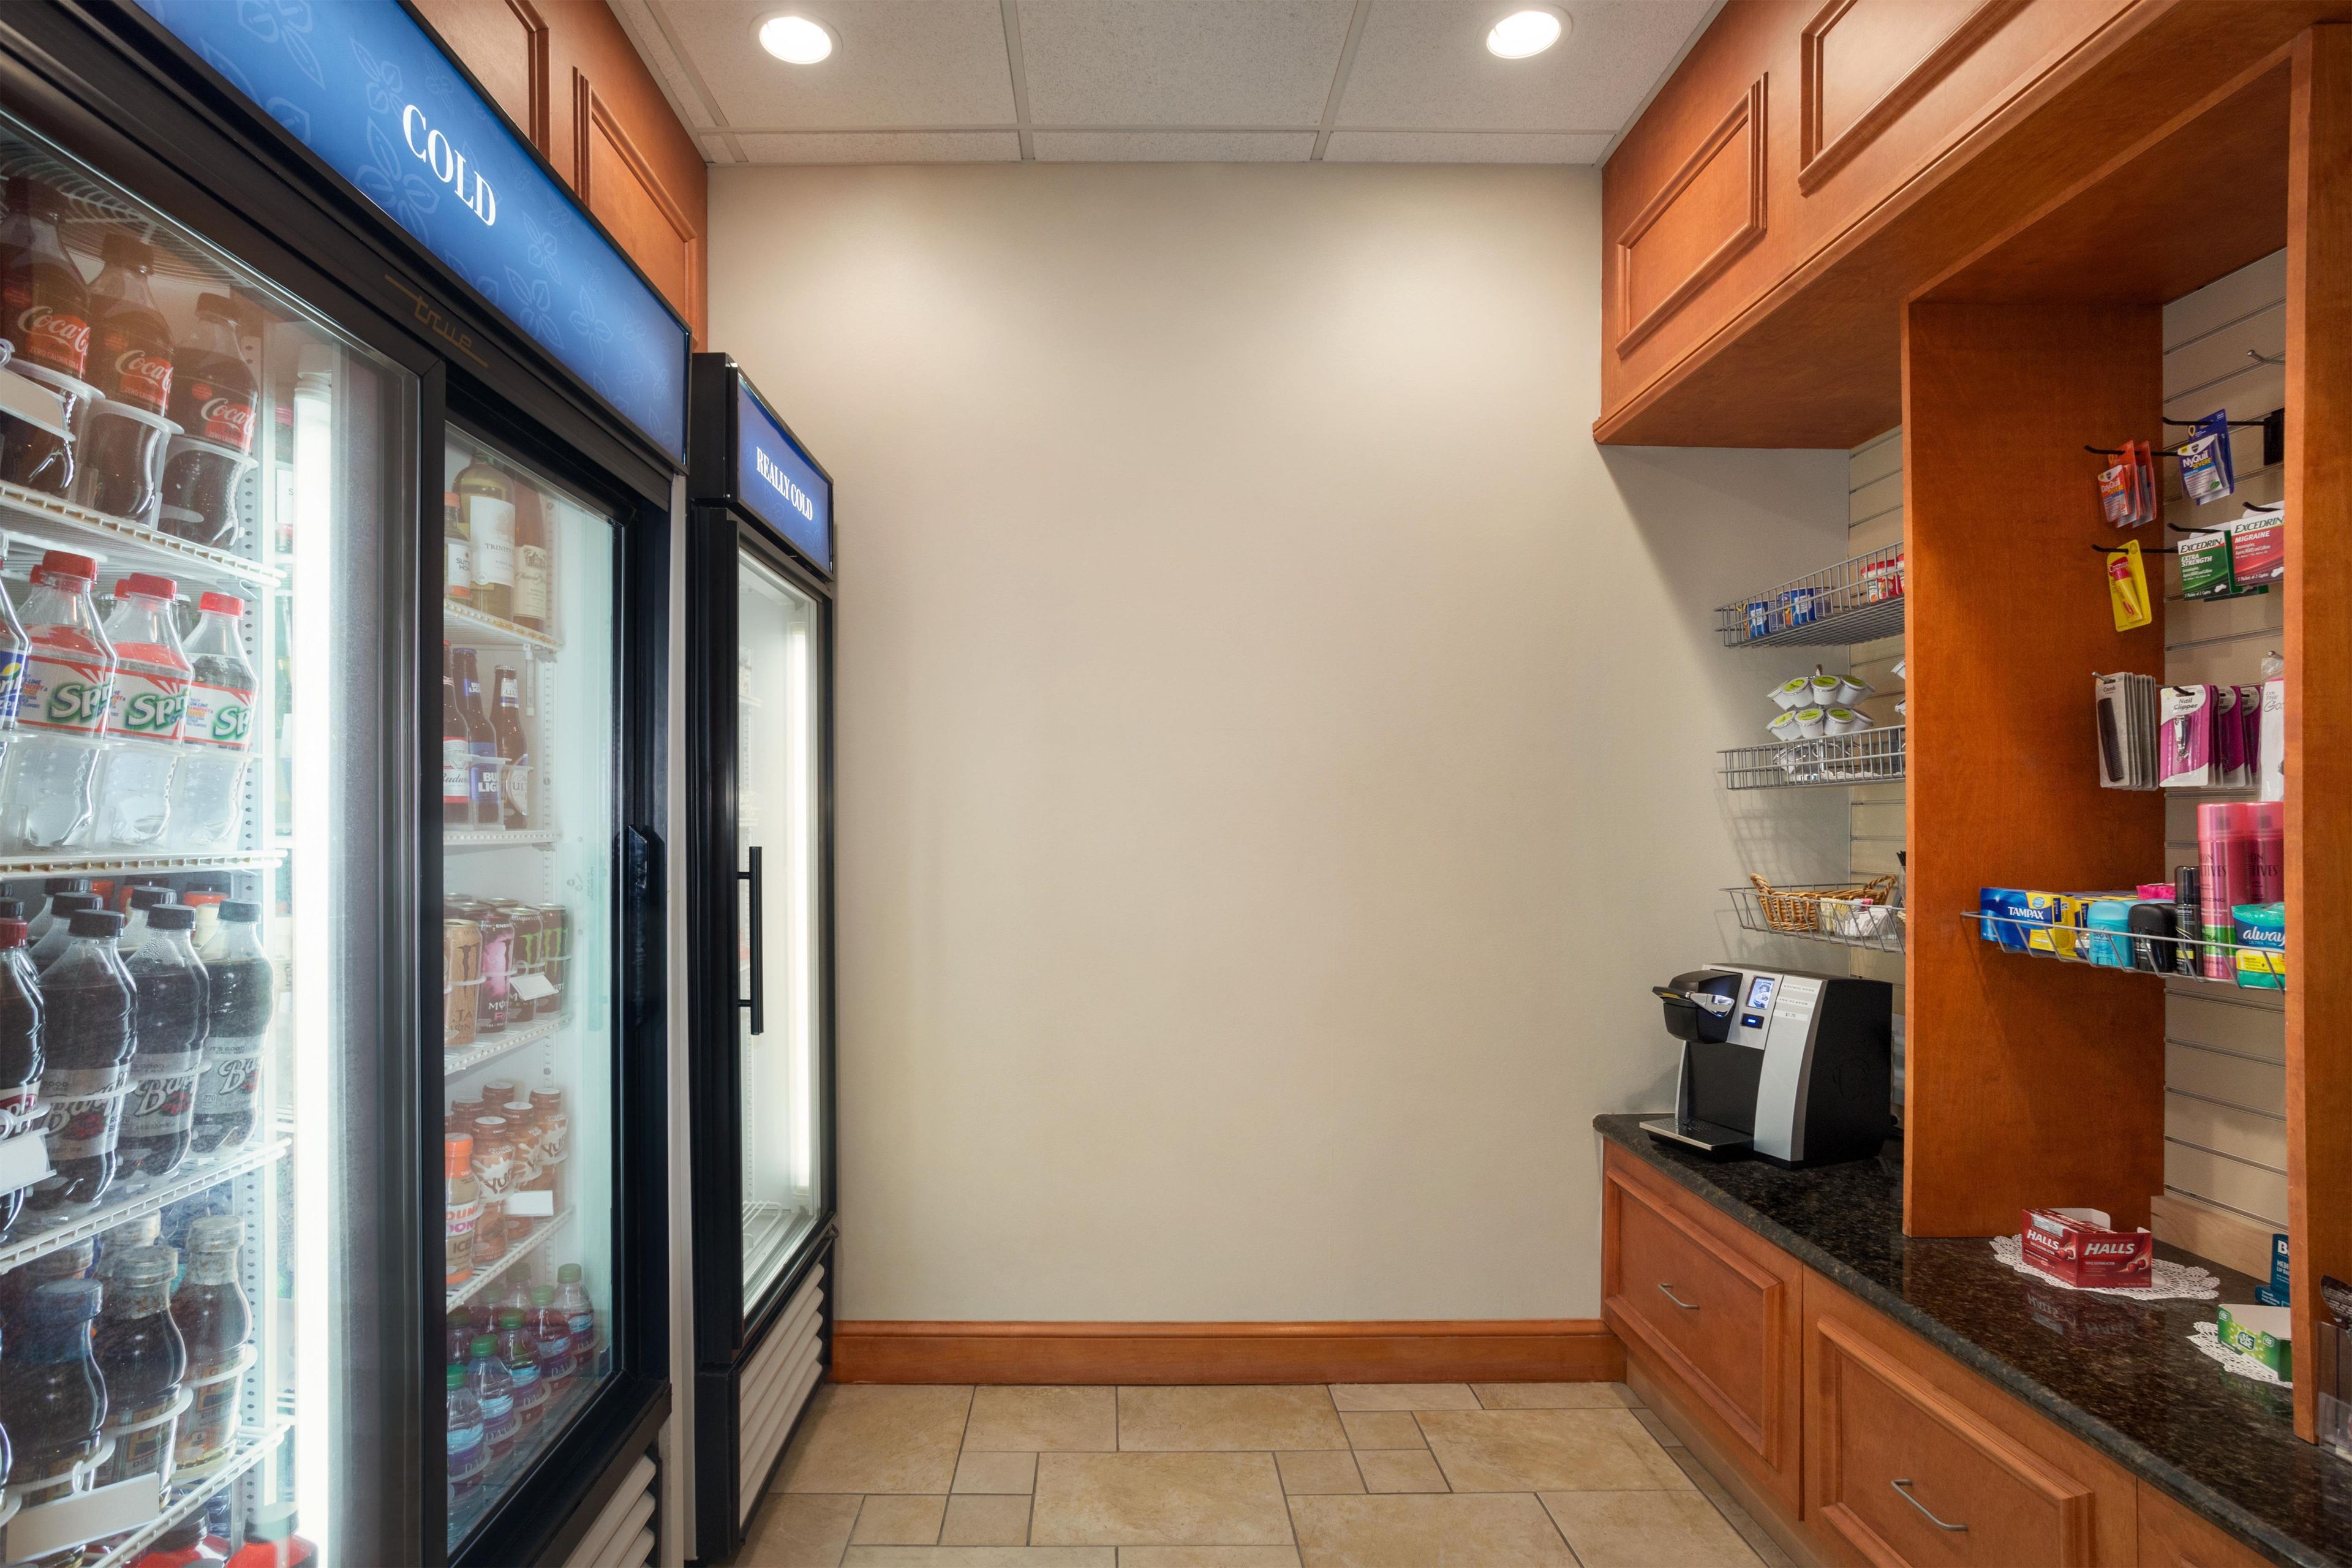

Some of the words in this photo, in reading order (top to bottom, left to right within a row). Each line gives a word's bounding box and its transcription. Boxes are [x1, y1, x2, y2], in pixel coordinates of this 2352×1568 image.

[402, 104, 496, 226] COLD
[2182, 450, 2209, 469] NyQuil
[2192, 458, 2212, 470] SEVERE
[756, 447, 790, 500] REALLY
[791, 483, 813, 521] COLD
[2234, 516, 2285, 534] EXCEDRIN
[2234, 530, 2271, 544] MIGRAINE
[2180, 537, 2223, 553] EXCEDRIN
[2181, 553, 2200, 562] EXTRA
[2181, 556, 2213, 568] STRENGTH
[2008, 906, 2044, 920] TAMPAX
[2027, 1229, 2060, 1251] HALLS
[2084, 1243, 2135, 1256] HALLS
